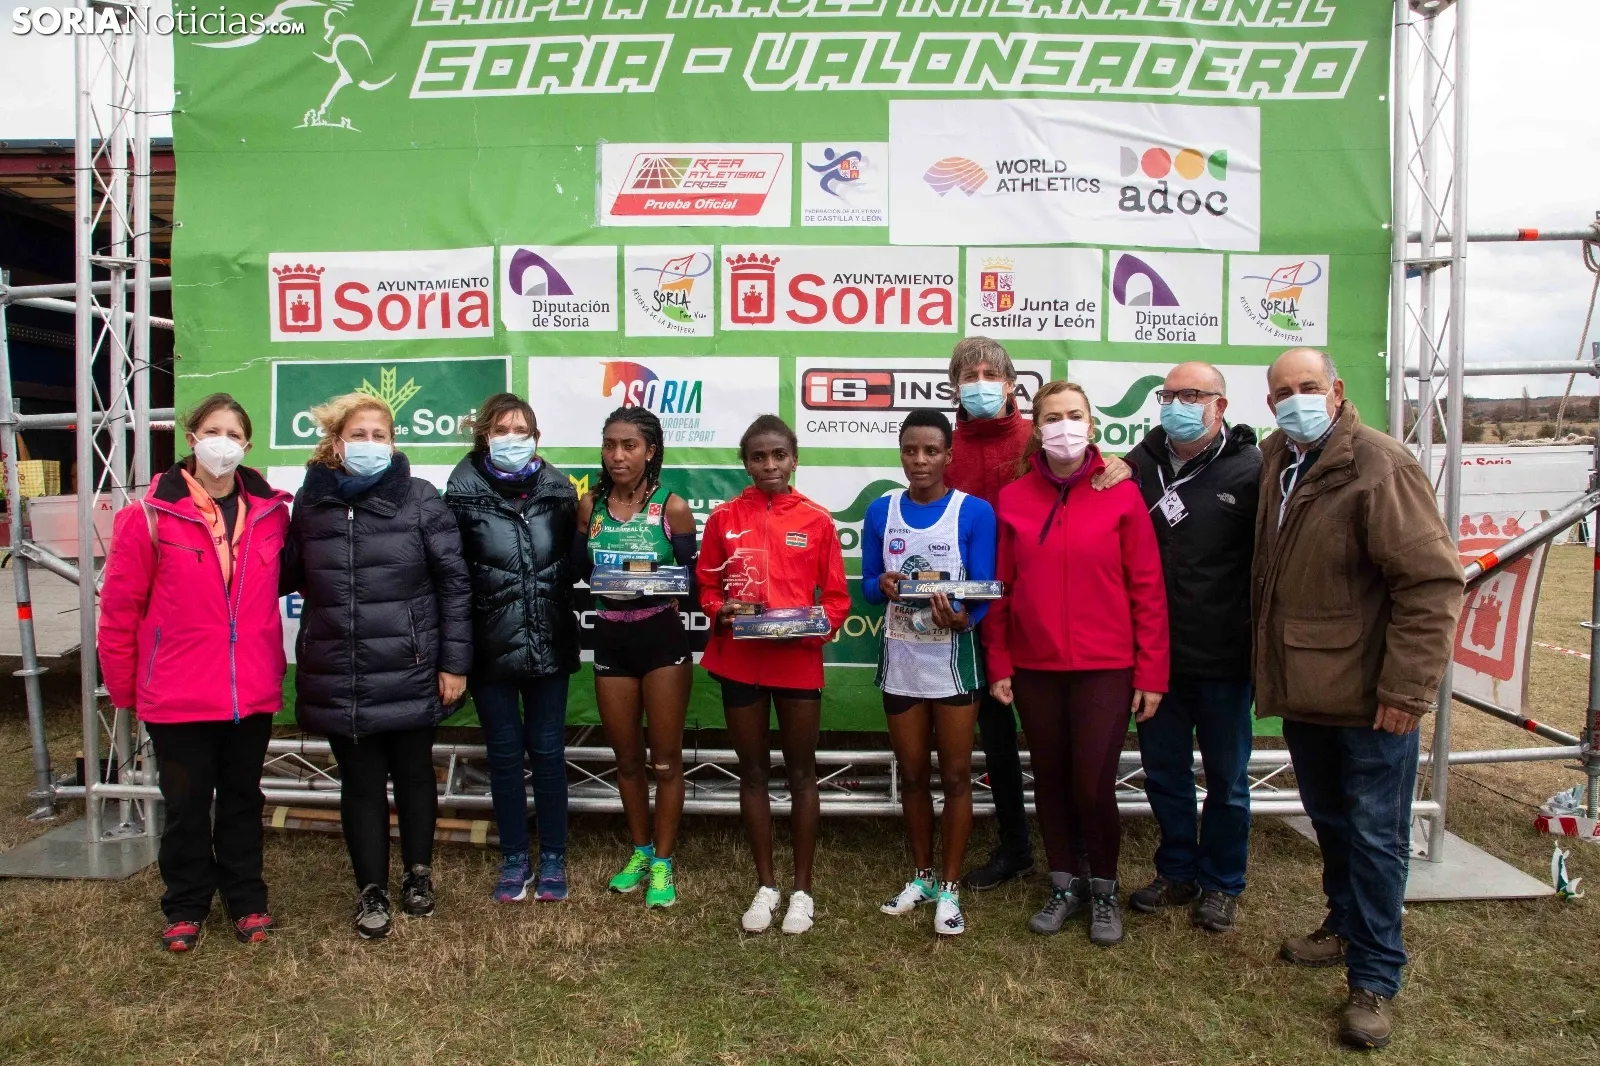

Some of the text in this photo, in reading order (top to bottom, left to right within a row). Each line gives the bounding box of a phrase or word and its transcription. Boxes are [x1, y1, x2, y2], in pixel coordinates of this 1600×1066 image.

[409, 34, 675, 99] SORIA
[743, 32, 1368, 99] VALONSADERO
[693, 158, 744, 169] RFEA
[996, 158, 1068, 175] WORLD
[688, 170, 766, 180] ATLETISMO
[683, 181, 728, 189] CROSS
[996, 177, 1100, 193] ATHLETICS
[643, 198, 738, 211] Prueba Oficial
[1118, 180, 1229, 217] adoc
[861, 213, 882, 222] LEÓN
[376, 277, 489, 292] AYUNTAMIENTO
[832, 273, 954, 286] AYUNTAMIENTO
[332, 281, 490, 332] Soria
[651, 289, 691, 312] SORIA
[785, 273, 953, 326] Soria
[1019, 298, 1096, 312] Junta de
[532, 300, 610, 317] Diputación
[1258, 298, 1300, 320] SORIA
[532, 314, 590, 328] de Soria
[970, 313, 1095, 331] Castilla y León
[1135, 310, 1219, 329] Diputación
[1135, 327, 1196, 342] de Soria
[675, 431, 687, 441] OF
[688, 430, 716, 442] SPORT
[603, 553, 617, 565] 27
